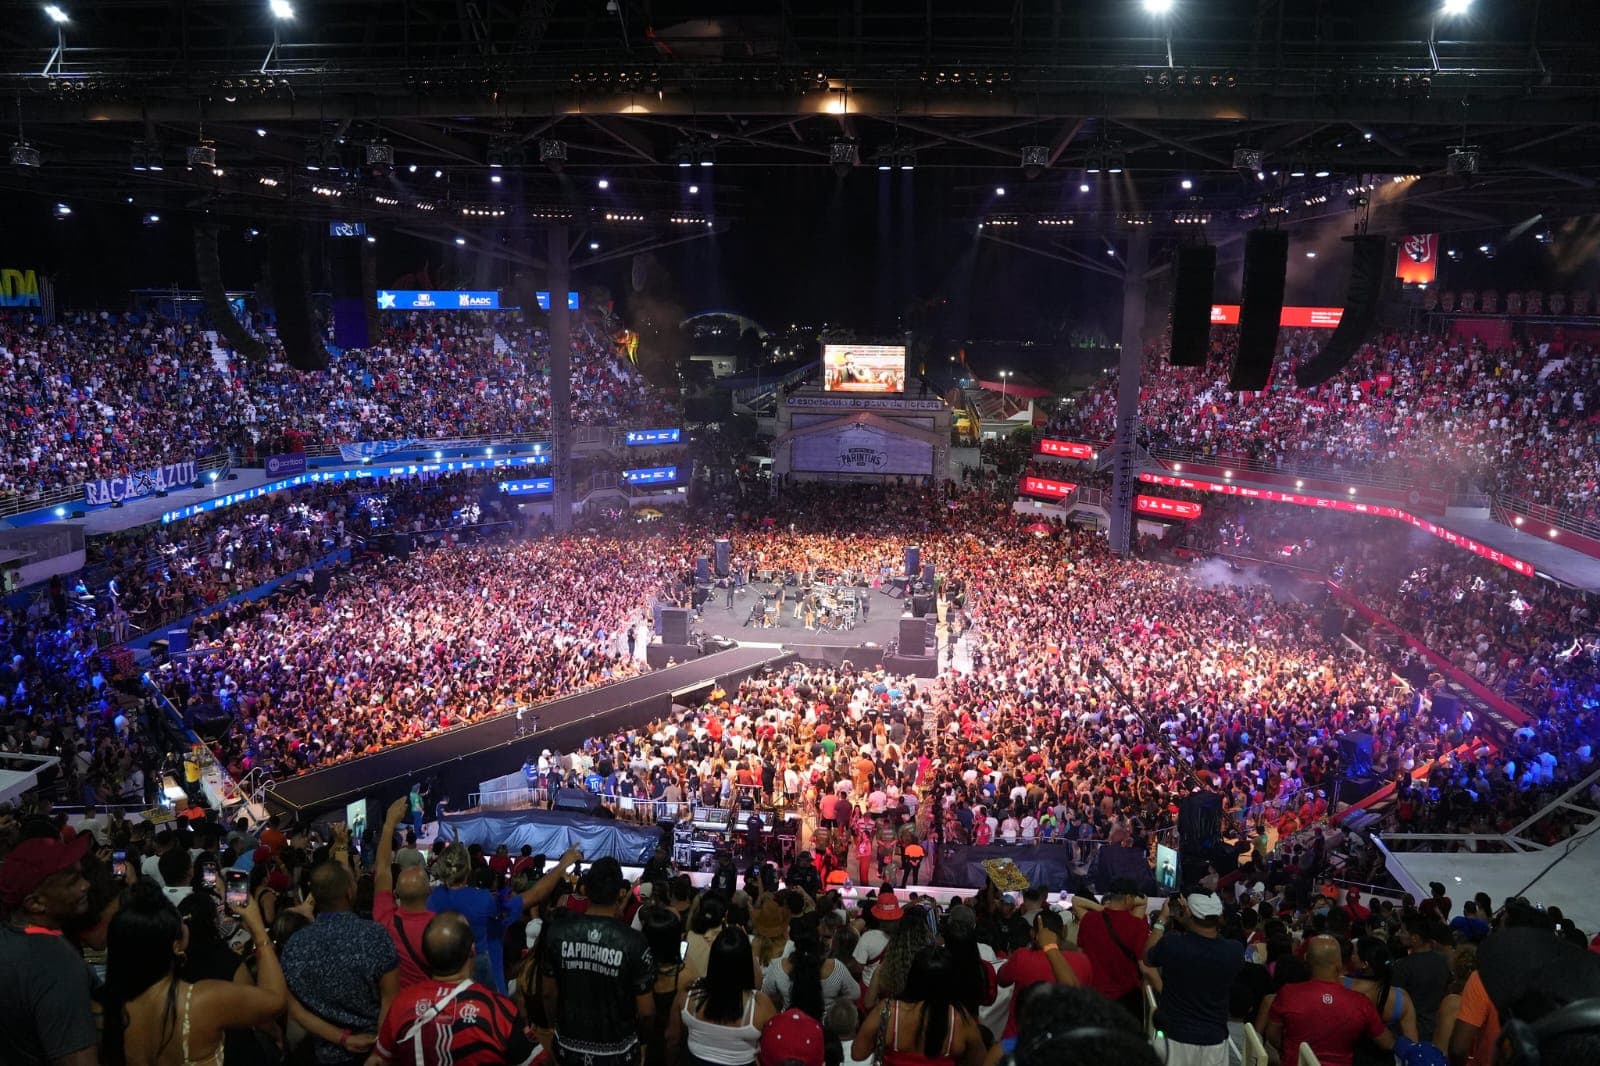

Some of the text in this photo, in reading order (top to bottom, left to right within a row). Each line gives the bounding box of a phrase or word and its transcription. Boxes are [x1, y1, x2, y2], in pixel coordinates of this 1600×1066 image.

[0, 269, 41, 307] DA
[842, 452, 881, 465] PARINTINS
[156, 461, 198, 489] AZUL
[561, 940, 623, 966] CAPRICHOSO
